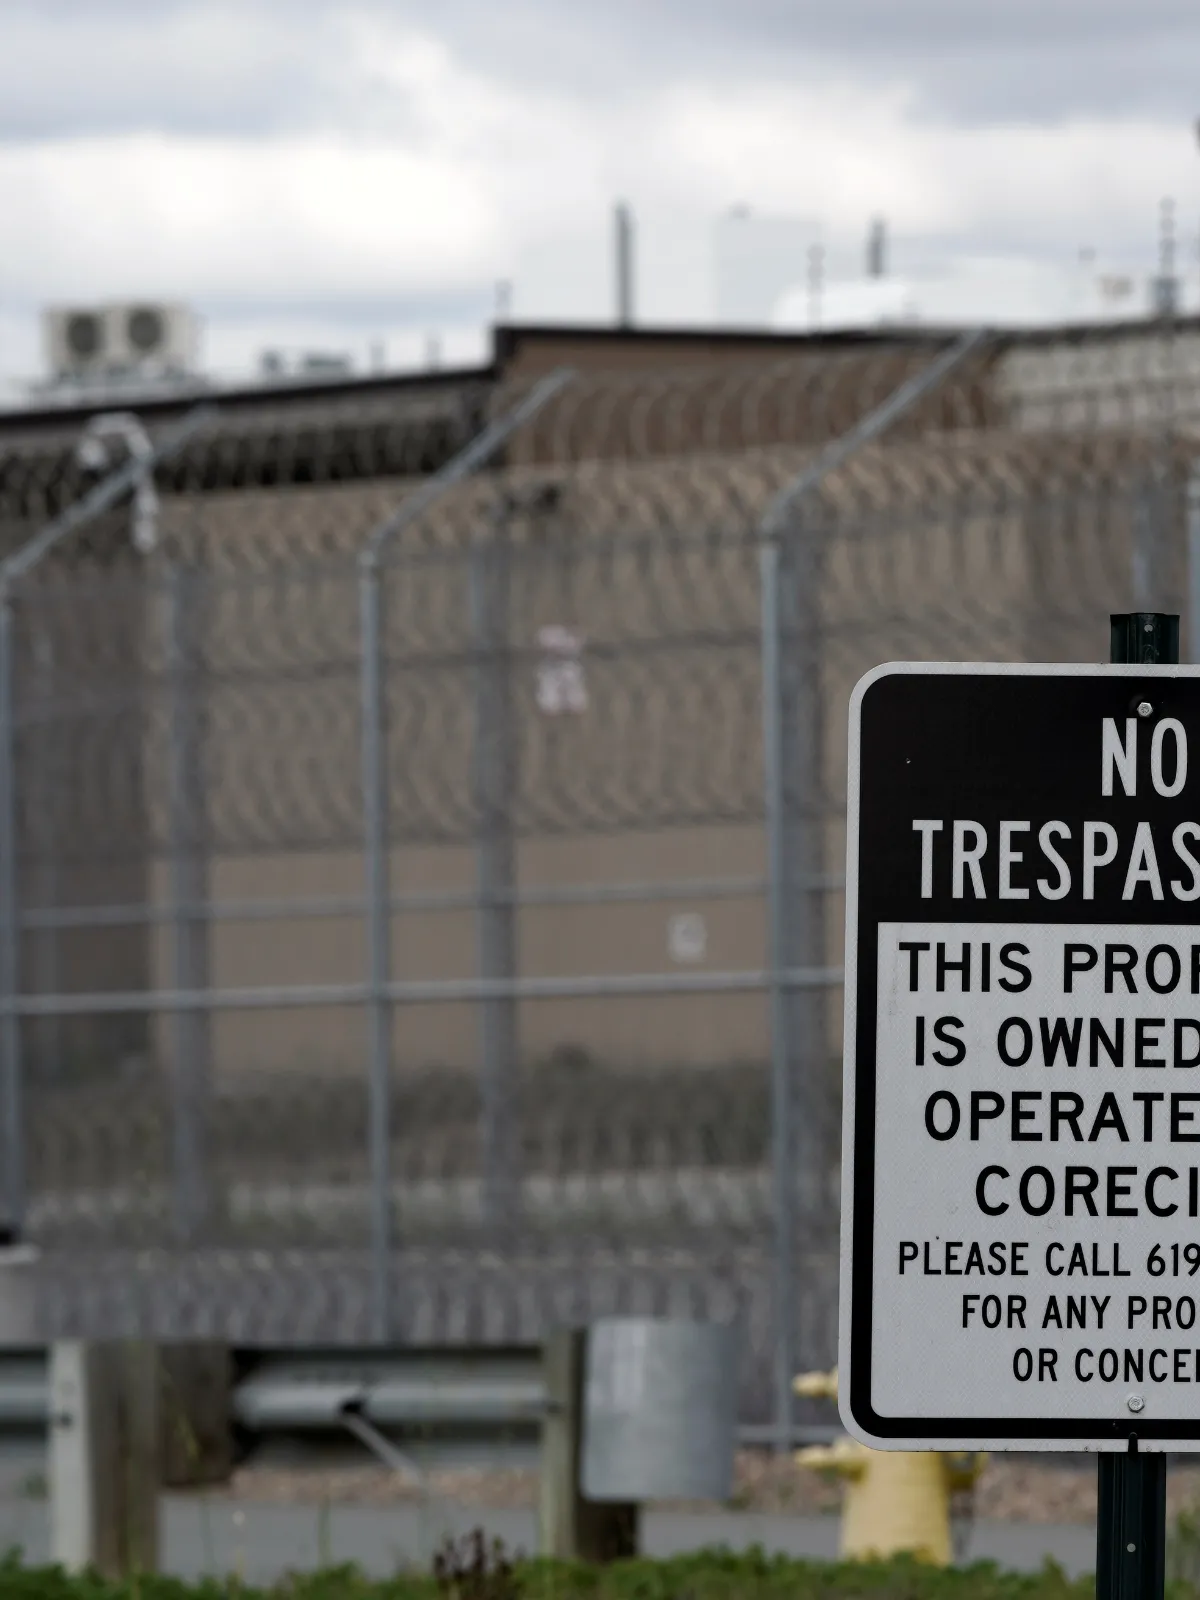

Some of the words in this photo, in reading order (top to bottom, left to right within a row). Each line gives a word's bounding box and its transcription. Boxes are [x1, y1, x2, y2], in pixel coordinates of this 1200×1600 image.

[1102, 717, 1188, 798] NO
[898, 942, 1032, 993] THIS
[915, 1016, 966, 1066] IS
[899, 1242, 1028, 1276] PLEASE
[1046, 1242, 1130, 1277] CALL
[962, 1295, 1026, 1329] FOR
[1042, 1296, 1111, 1330] ANY
[1013, 1348, 1057, 1382] OR
